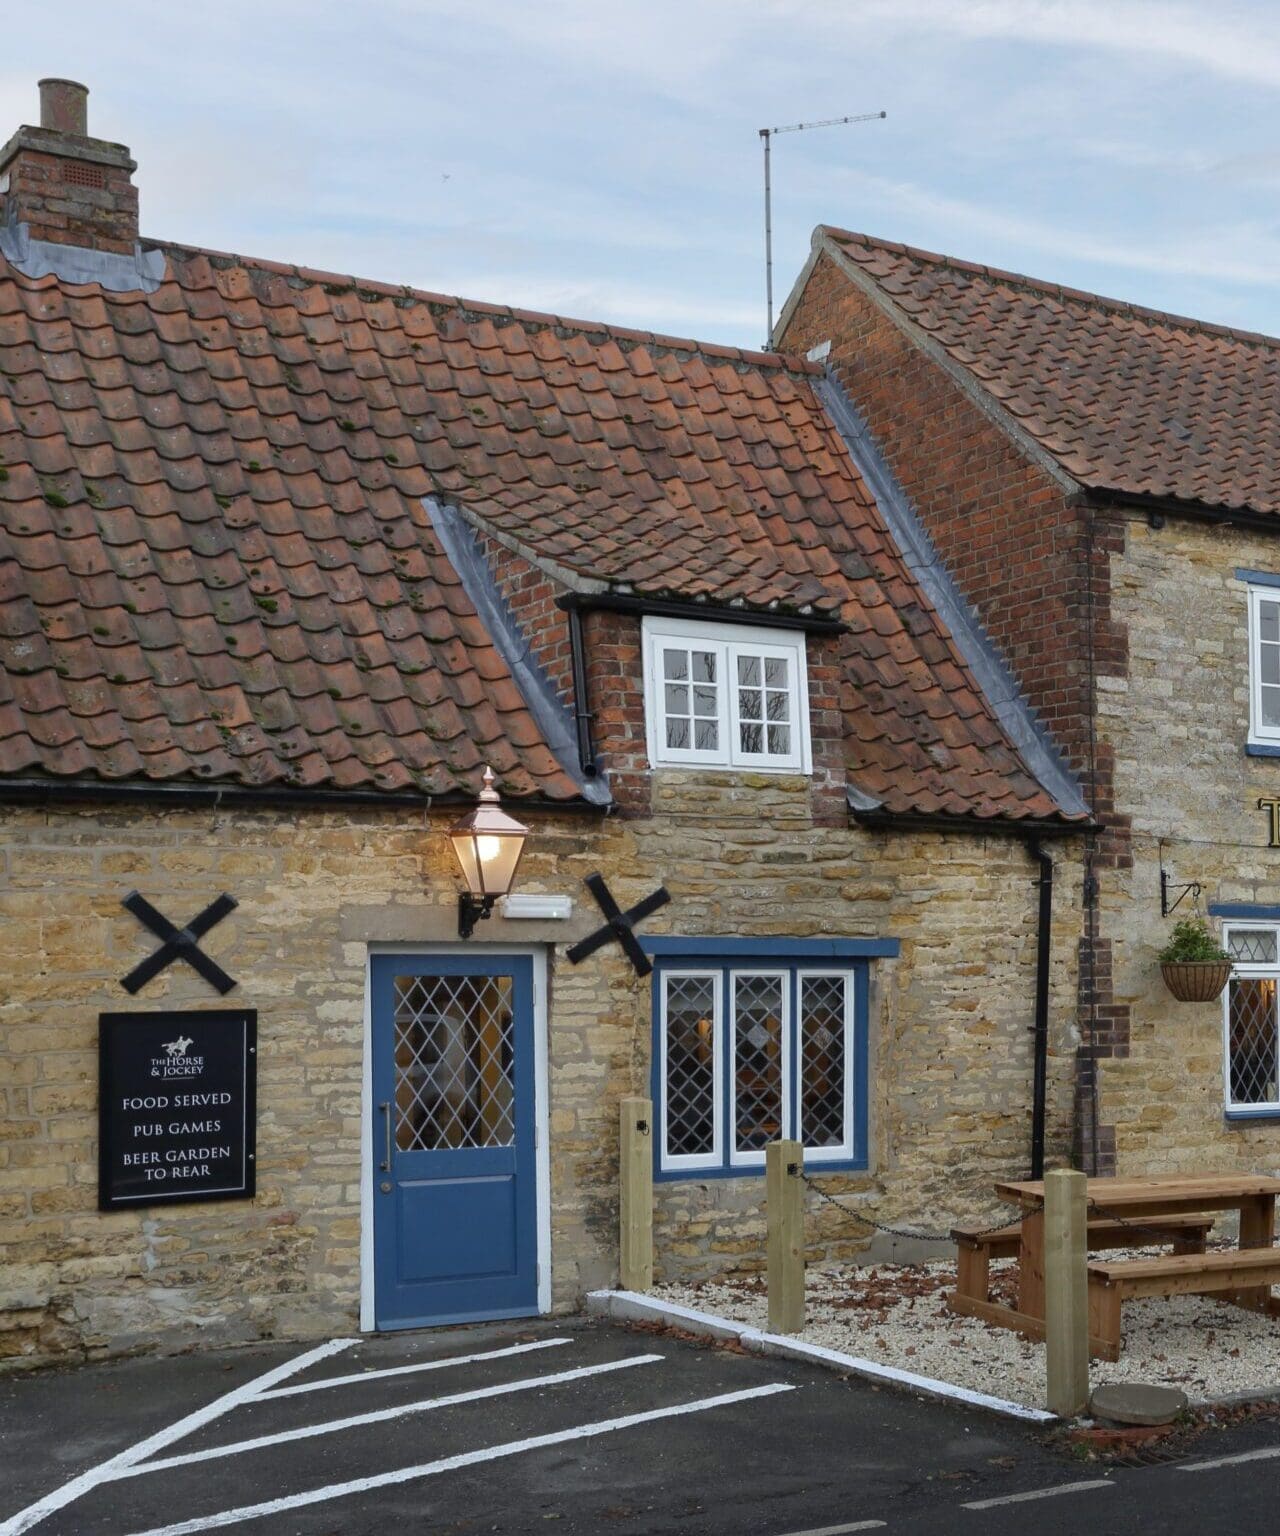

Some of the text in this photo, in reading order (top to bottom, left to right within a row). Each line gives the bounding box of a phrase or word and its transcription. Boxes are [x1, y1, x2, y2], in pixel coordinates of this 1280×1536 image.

[151, 1056, 204, 1067] THE HORSE
[151, 1066, 204, 1077] & JOCKEY
[122, 1092, 231, 1110] FOOD SERVED
[134, 1120, 221, 1137] PUB GAMES
[123, 1146, 231, 1166] BEER GARDEN
[144, 1165, 211, 1181] TO REAR
